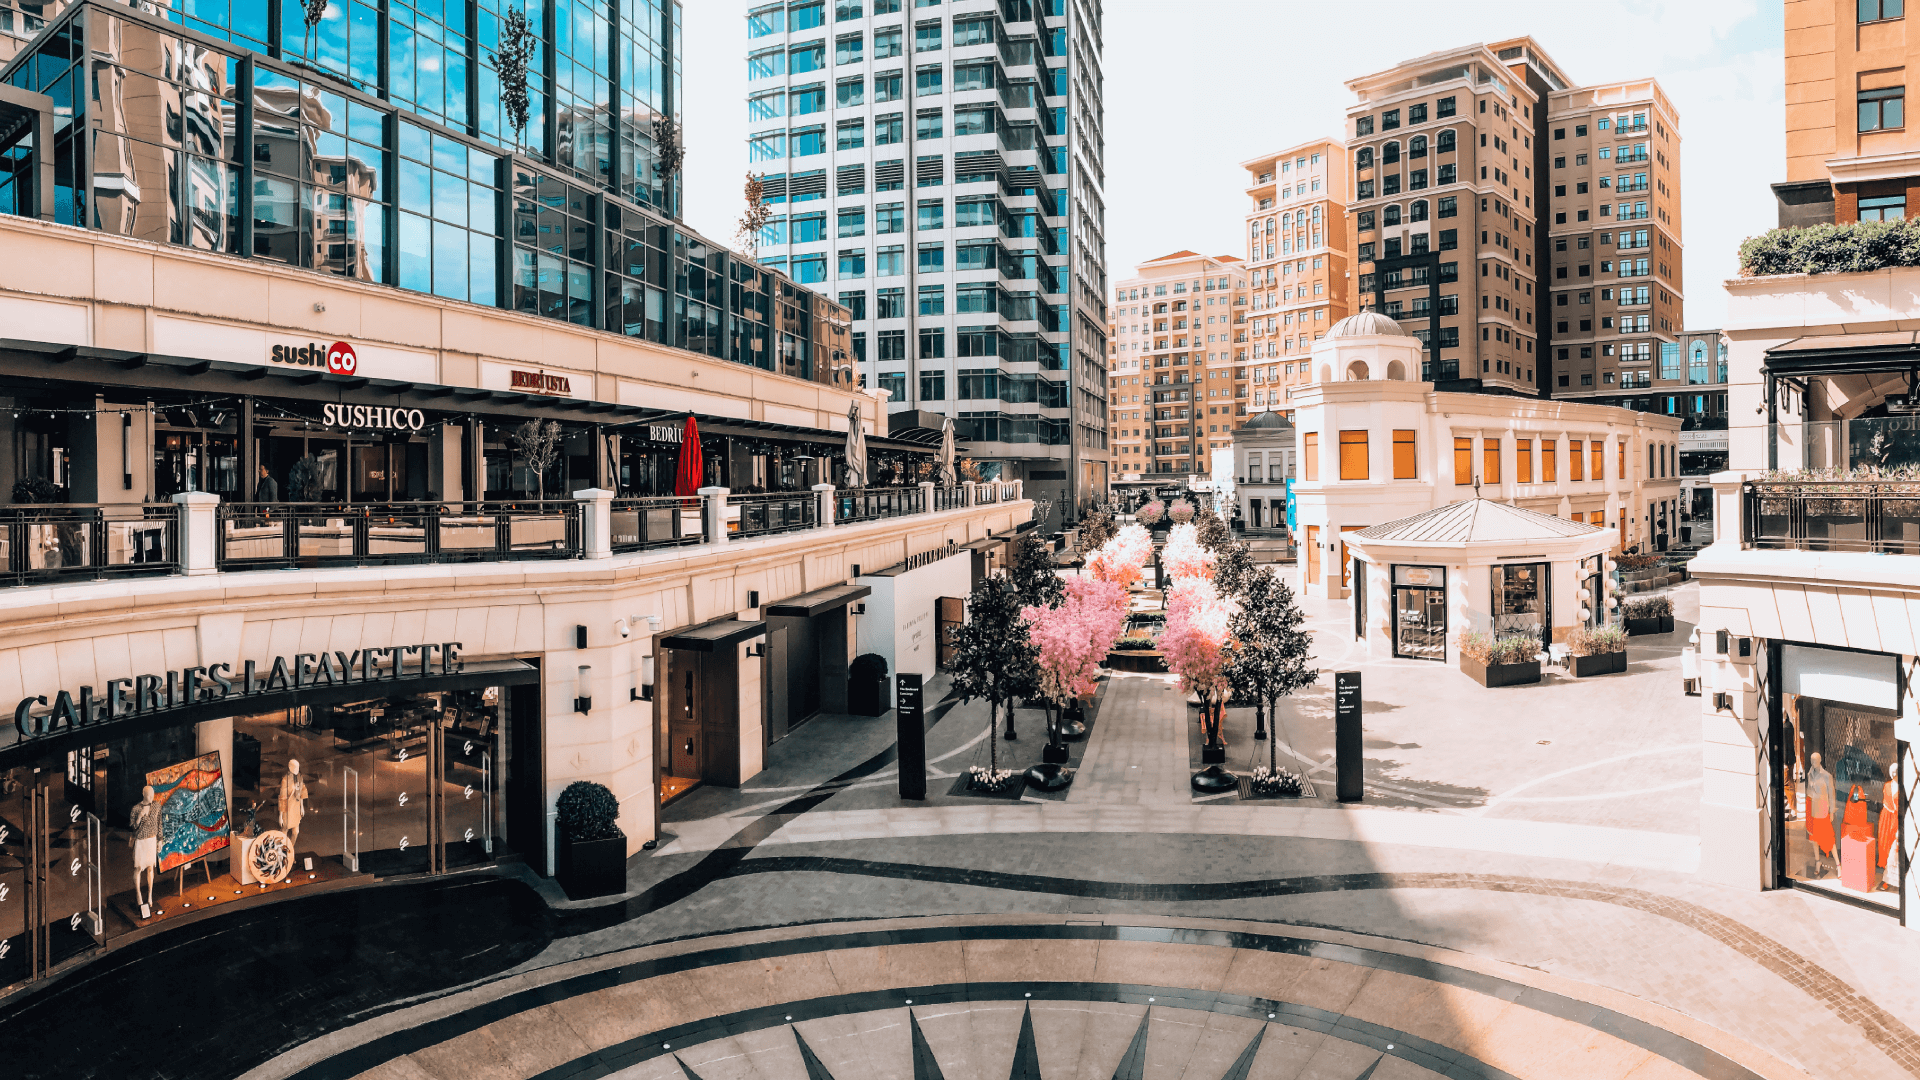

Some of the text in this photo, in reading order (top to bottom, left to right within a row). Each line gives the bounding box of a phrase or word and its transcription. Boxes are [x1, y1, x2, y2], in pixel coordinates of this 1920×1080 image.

[322, 403, 425, 431] SUSHICO
[14, 641, 465, 739] GALERIES LAFAYETTE
